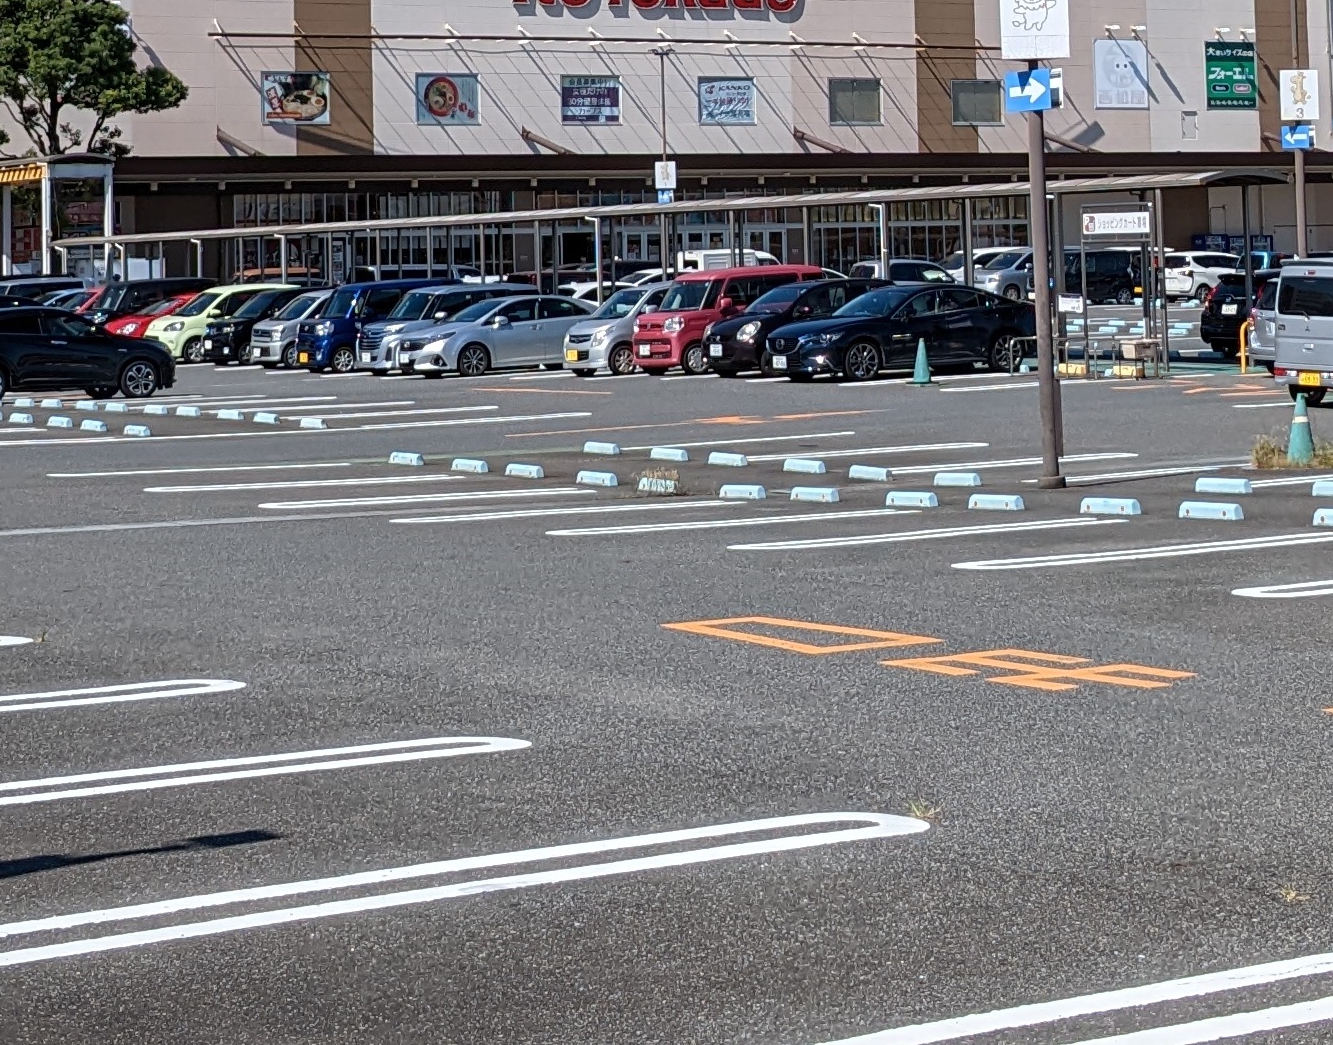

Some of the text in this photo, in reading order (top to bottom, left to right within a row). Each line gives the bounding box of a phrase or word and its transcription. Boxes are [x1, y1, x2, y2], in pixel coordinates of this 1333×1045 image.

[1208, 67, 1254, 80] フォーエル
[1296, 107, 1304, 119] 3
